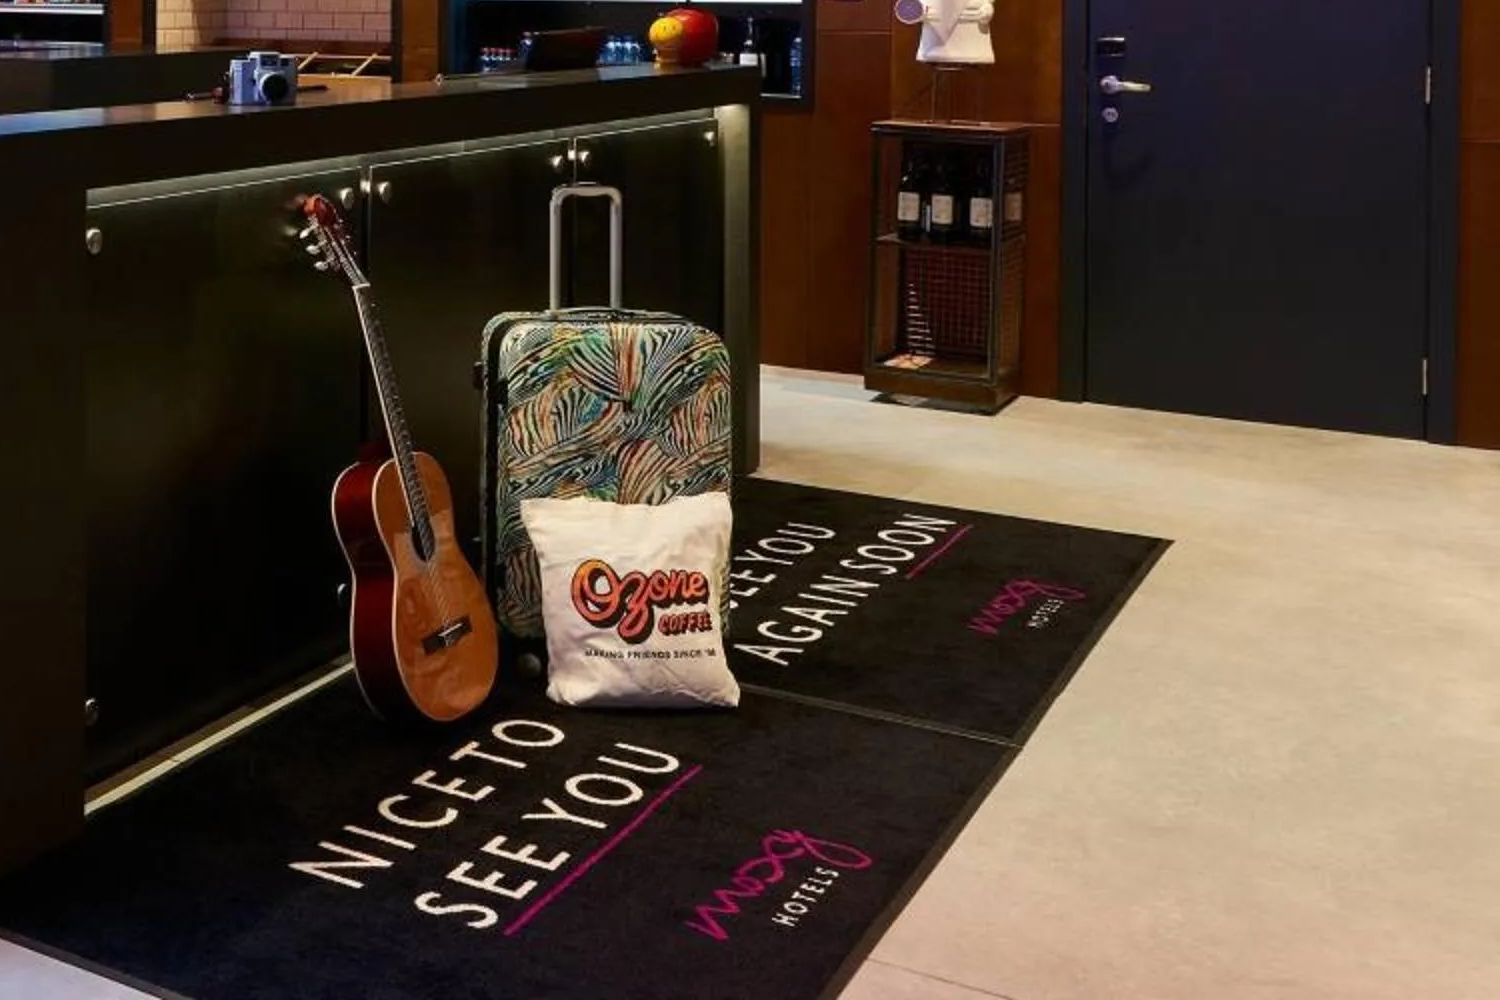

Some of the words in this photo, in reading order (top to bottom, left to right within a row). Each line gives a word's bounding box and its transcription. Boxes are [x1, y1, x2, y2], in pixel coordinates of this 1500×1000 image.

[733, 521, 836, 566] YOU
[571, 559, 710, 644] Ozone
[658, 611, 712, 636] COFFEE
[729, 569, 777, 609] EE
[732, 574, 881, 666] AGAIN
[839, 513, 957, 575] SOON
[627, 650, 671, 660] FRIENDS
[673, 649, 702, 659] SINCE
[287, 769, 496, 889] NICE
[449, 718, 565, 769] TO
[414, 834, 572, 929] SEE
[521, 742, 681, 830] YOU
[684, 829, 873, 941] moxy
[771, 866, 841, 928] HOTELS
